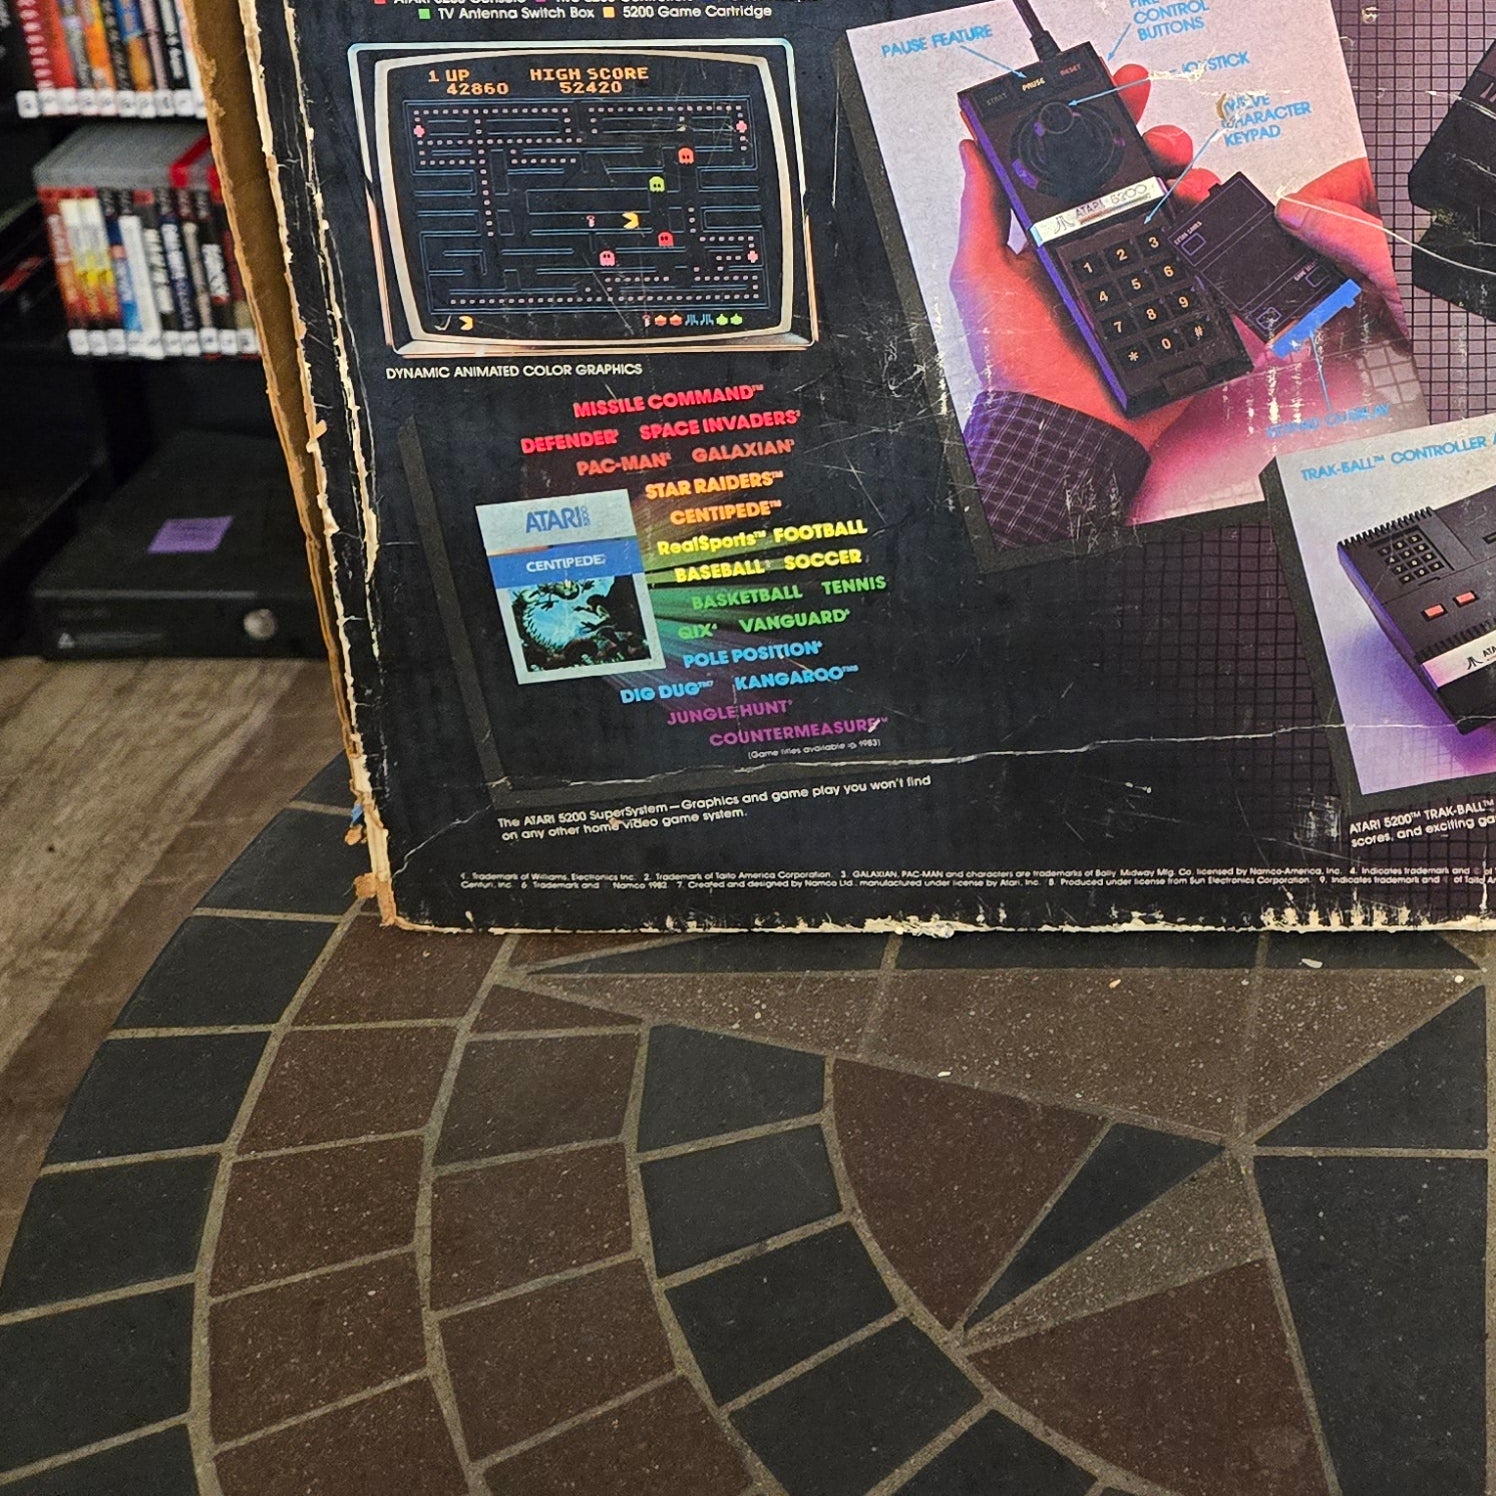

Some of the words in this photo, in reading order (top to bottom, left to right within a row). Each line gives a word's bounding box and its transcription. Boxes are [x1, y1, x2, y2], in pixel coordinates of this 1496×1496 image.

[1137, 15, 1205, 42] BUTTONS
[881, 39, 929, 59] PAUSE
[931, 24, 993, 47] FEATURE
[429, 69, 439, 82] 1
[446, 69, 470, 82] UP
[530, 68, 581, 81] HIGH
[587, 67, 649, 81] SCORE
[1022, 77, 1046, 92] PAUSE
[446, 82, 509, 95] 42860
[560, 81, 622, 94] 52420
[1224, 123, 1281, 147] KEYPAD
[1074, 201, 1106, 219] ATARI
[1109, 182, 1147, 208] 5200
[386, 366, 450, 380] DYNAMIC
[453, 365, 520, 378] ANIMATED
[522, 364, 572, 378] COLOR
[575, 363, 643, 376] GRAPHICS
[573, 396, 645, 418] MISSILE
[639, 421, 699, 441] SPACE
[1390, 435, 1486, 465] CONTROLLER
[645, 479, 691, 500] STAR
[525, 508, 584, 533] ATARI
[773, 520, 868, 543] FOOTBALL
[675, 559, 765, 583] BASEBALL
[783, 549, 862, 571] SOCCER
[692, 585, 803, 610] BASKETBALL
[822, 576, 887, 595] TENNIS
[683, 650, 729, 668] POLE
[620, 687, 655, 704] DIG
[667, 706, 738, 725] JUNGLE
